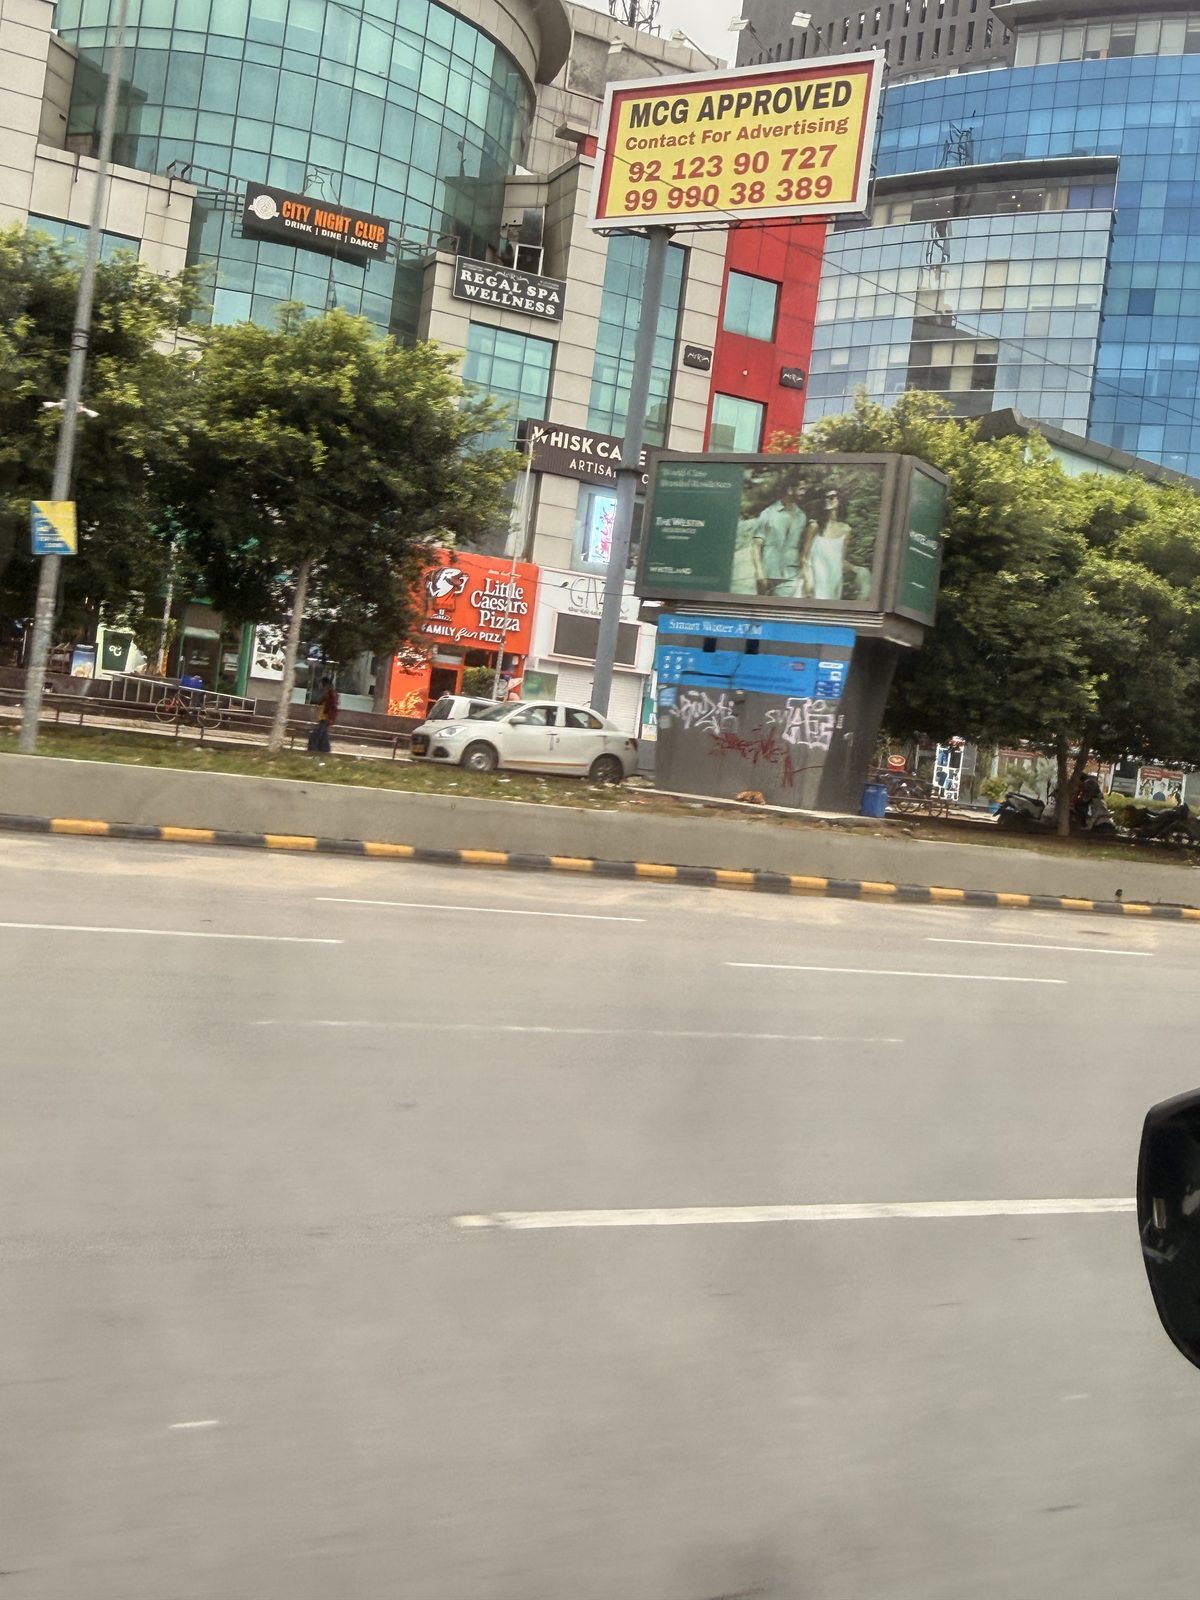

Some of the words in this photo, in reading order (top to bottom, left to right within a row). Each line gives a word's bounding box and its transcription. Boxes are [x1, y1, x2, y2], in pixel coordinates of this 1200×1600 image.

[630, 100, 689, 129] MCG
[696, 80, 852, 122] APPROVED
[625, 131, 696, 150] Contact
[701, 129, 732, 144] For
[737, 115, 850, 140] Advertising
[628, 160, 662, 183] 92
[671, 155, 723, 180] 123
[733, 151, 769, 175] 90
[781, 144, 838, 171] 727
[624, 189, 657, 211] 99
[667, 184, 720, 209] 990
[729, 180, 766, 204] 38
[776, 175, 833, 201] 389
[282, 200, 311, 222] CITY
[314, 209, 352, 233] NIGHT
[355, 220, 385, 243] CLUB
[284, 220, 312, 232] DRINK
[321, 230, 342, 240] DINE
[350, 237, 379, 250] DANCE
[460, 269, 522, 293] REGAL
[526, 286, 560, 302] SPA
[464, 284, 556, 314] WELLNESS
[596, 442, 647, 466] CAE
[470, 590, 528, 615] Caesars
[484, 577, 524, 599] Little
[479, 610, 521, 632] Pizza
[479, 631, 505, 643] PIZZ
